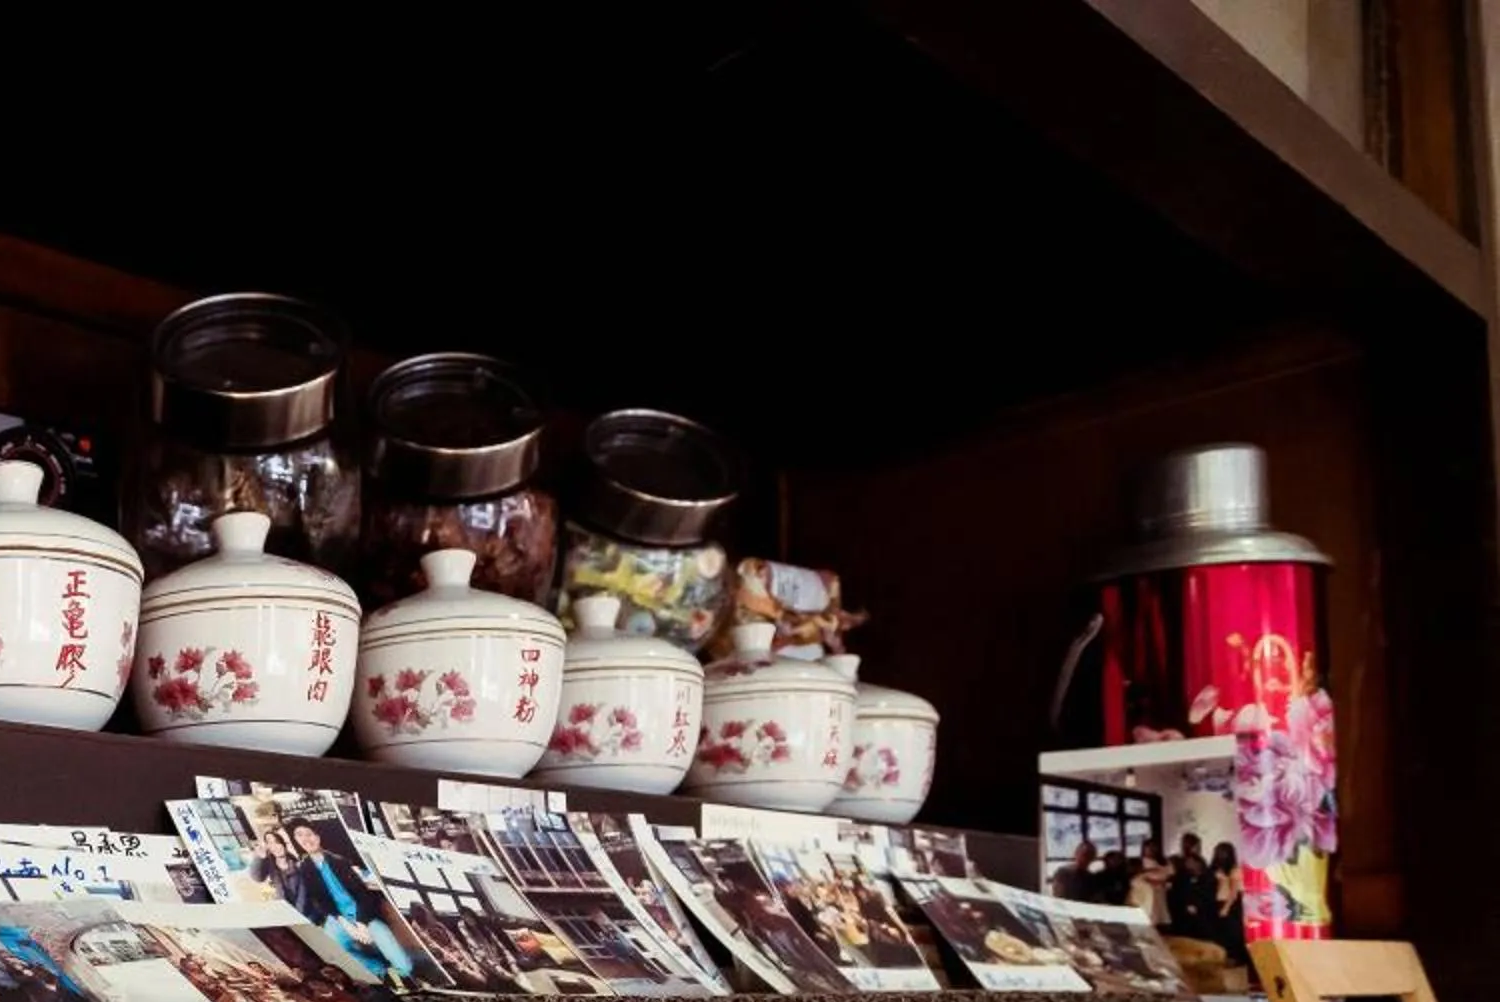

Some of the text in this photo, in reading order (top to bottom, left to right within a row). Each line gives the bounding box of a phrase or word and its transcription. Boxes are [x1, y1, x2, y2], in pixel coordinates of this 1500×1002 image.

[307, 611, 337, 702] 龍眼肉
[511, 649, 541, 724] 四神粉
